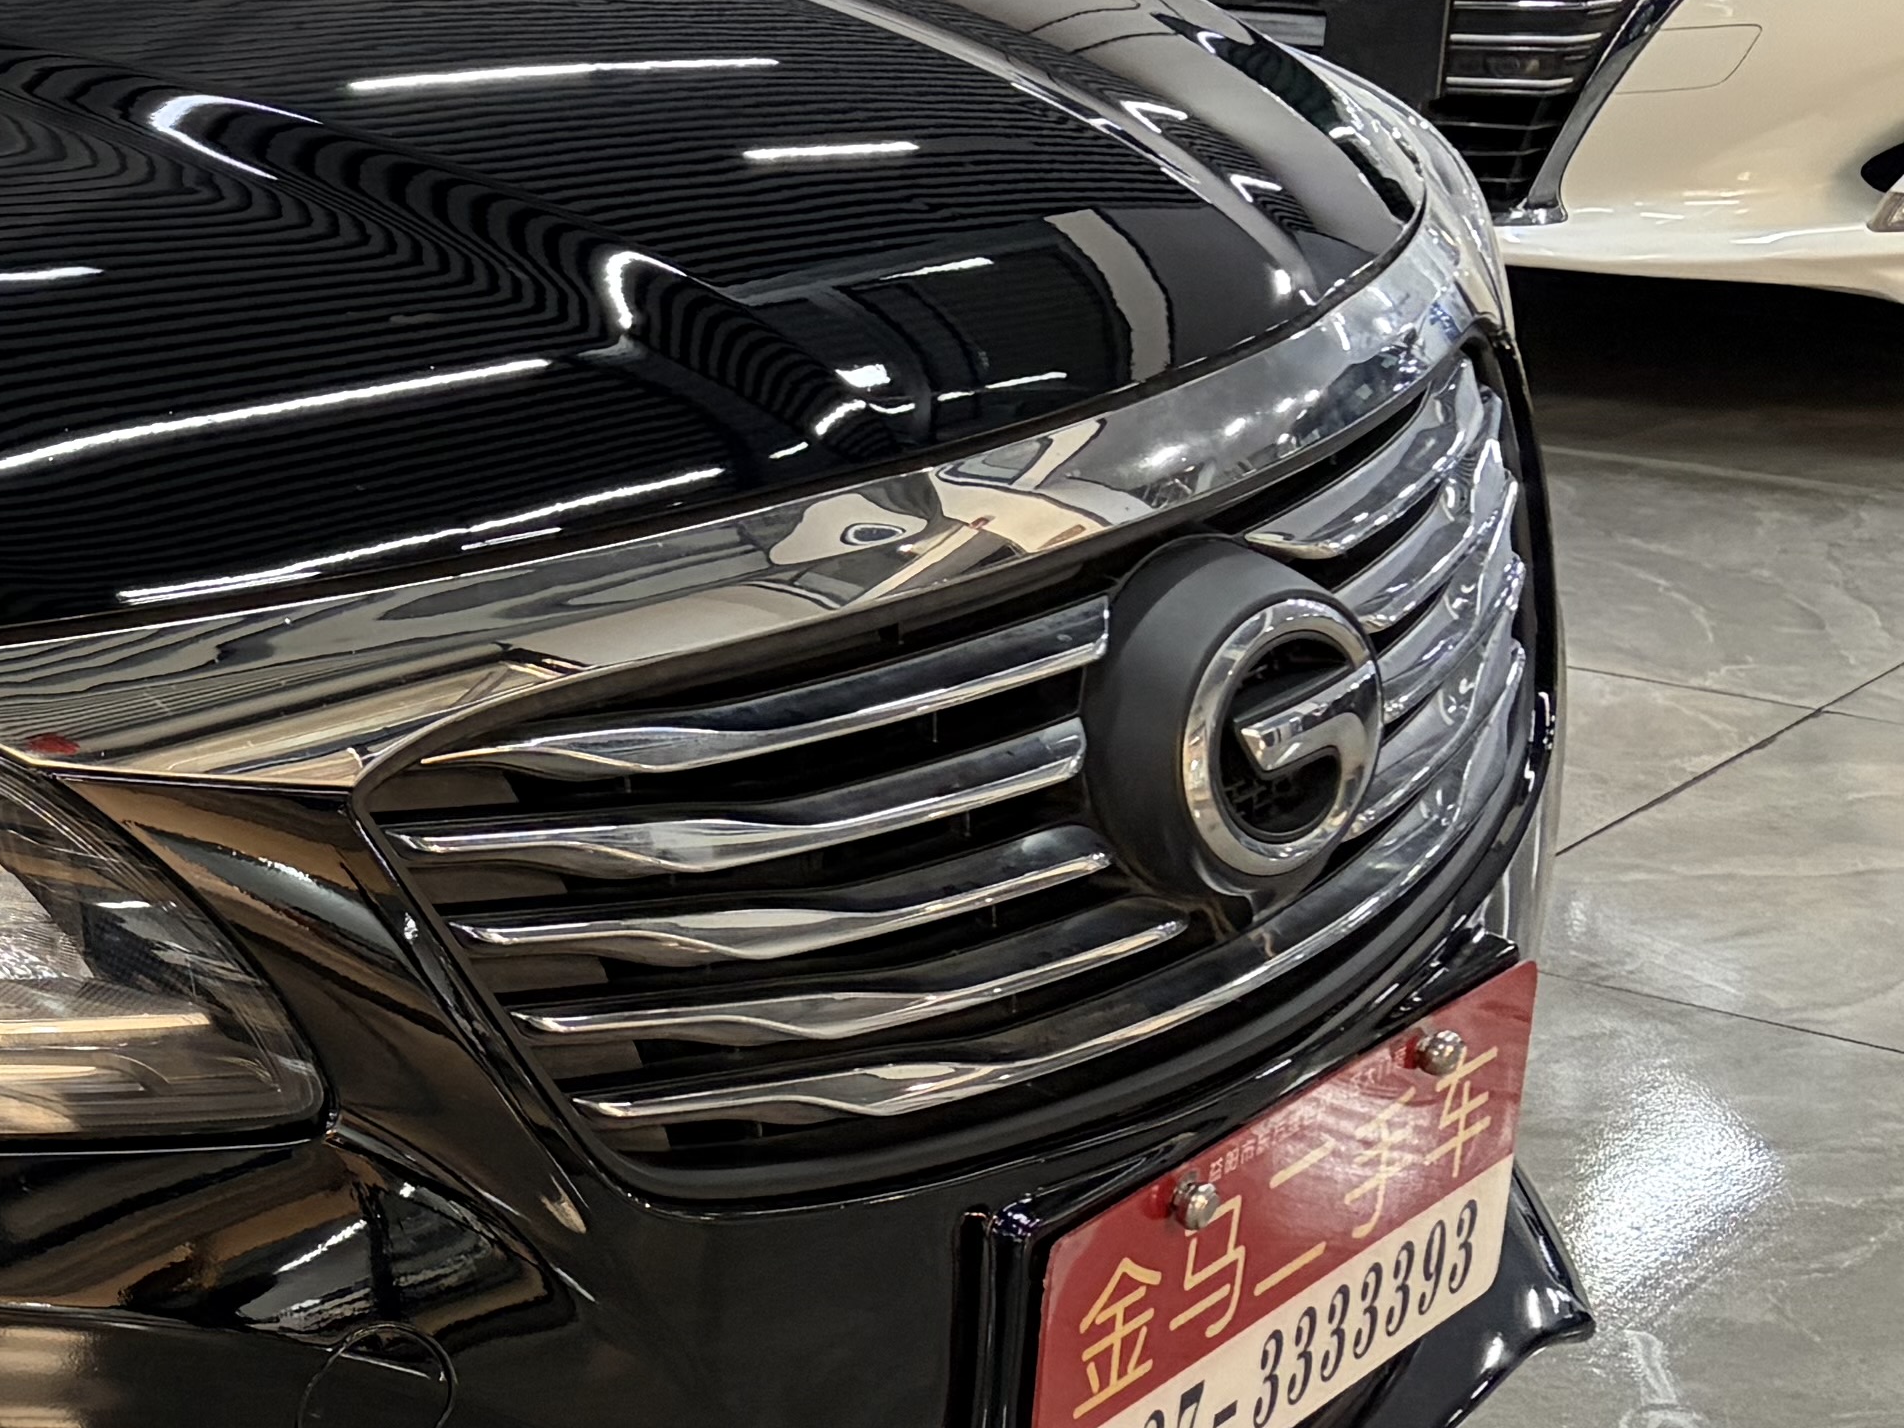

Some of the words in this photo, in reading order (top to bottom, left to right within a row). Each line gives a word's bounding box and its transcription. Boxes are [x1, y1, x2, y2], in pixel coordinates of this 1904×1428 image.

[1073, 1046, 1498, 1419] 金马二手车
